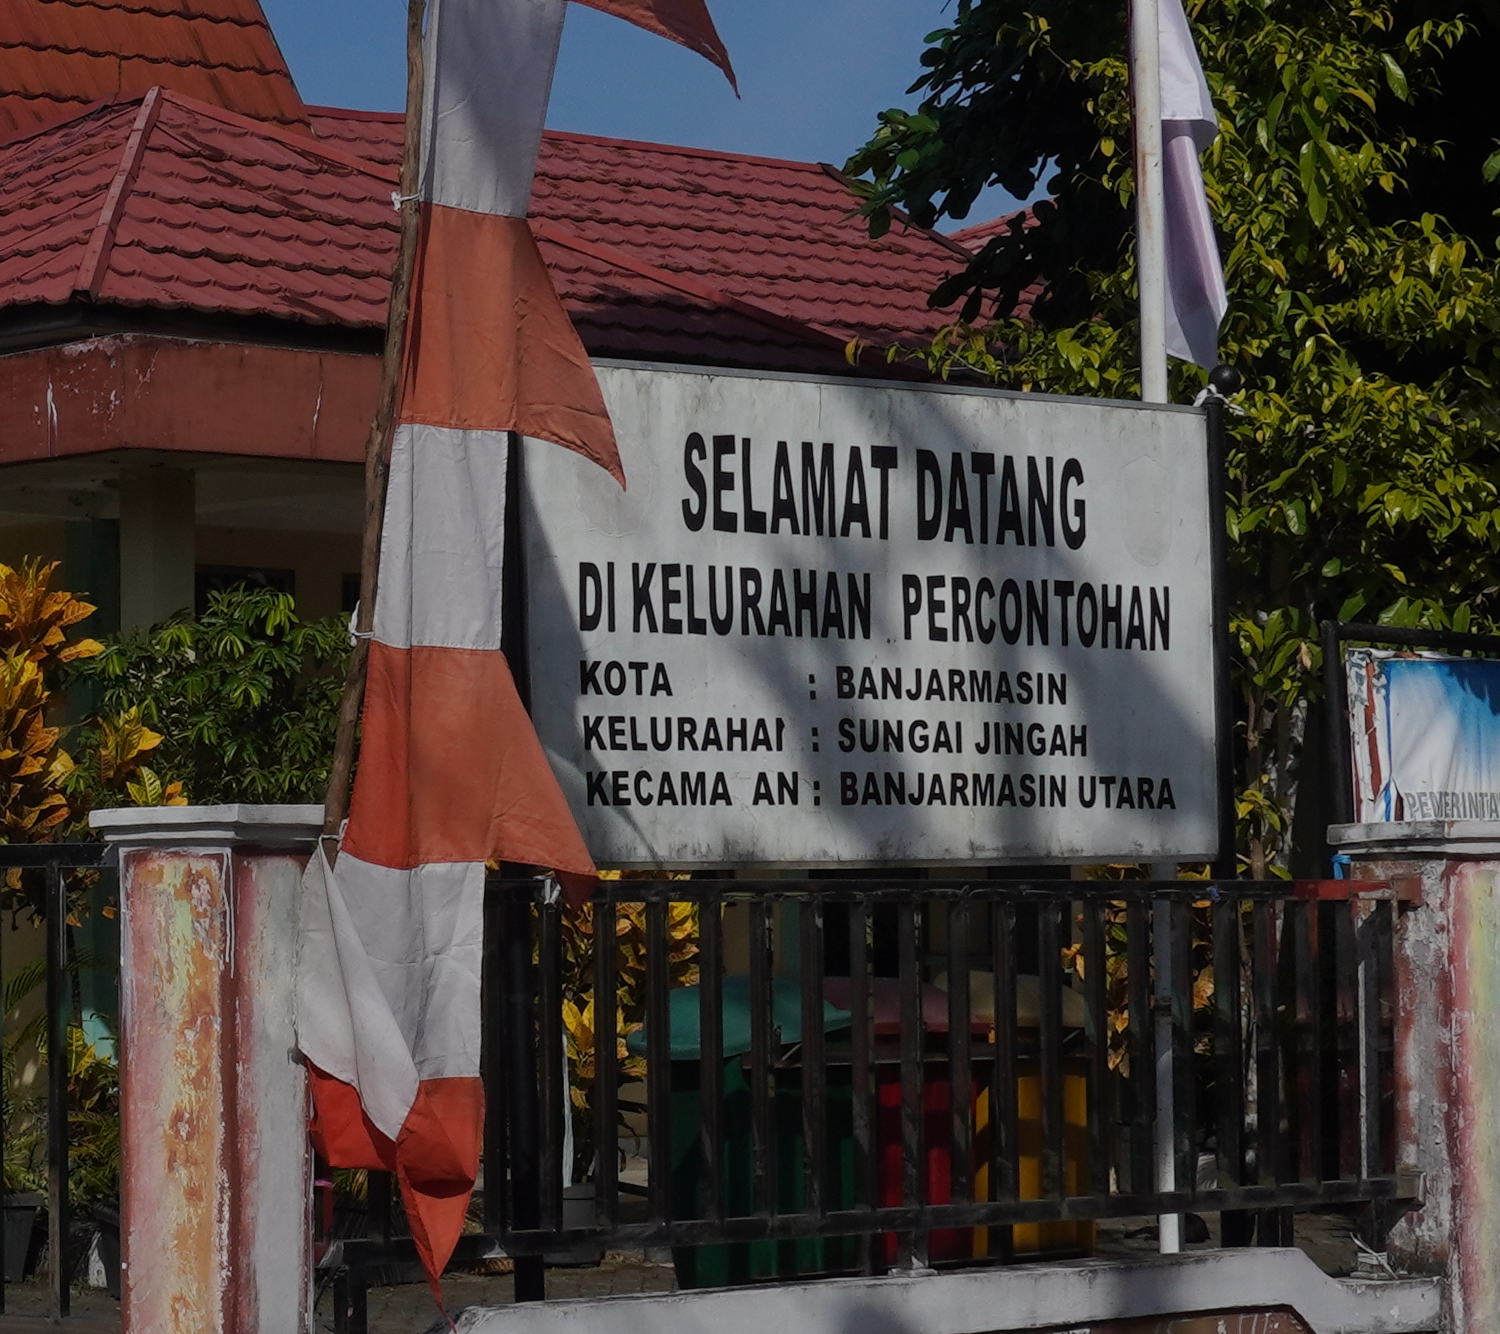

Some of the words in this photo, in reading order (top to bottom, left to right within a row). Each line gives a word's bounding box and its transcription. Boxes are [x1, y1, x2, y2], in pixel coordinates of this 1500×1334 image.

[682, 432, 898, 540] SELAMAT
[916, 449, 1087, 550] DATANG
[579, 562, 615, 633] DI
[632, 562, 872, 640] KELURAHAN
[903, 573, 1170, 651] PERCONTOHAN
[579, 660, 673, 697] KOTA
[808, 673, 817, 700] :
[836, 666, 1067, 705] BANJARMASIN
[812, 727, 820, 753] :
[838, 719, 963, 754] SUNGAI
[975, 721, 1088, 757] JINGAH
[814, 781, 821, 807] :
[840, 771, 1067, 808] BANJARMASIN
[1078, 775, 1176, 810] UTARA
